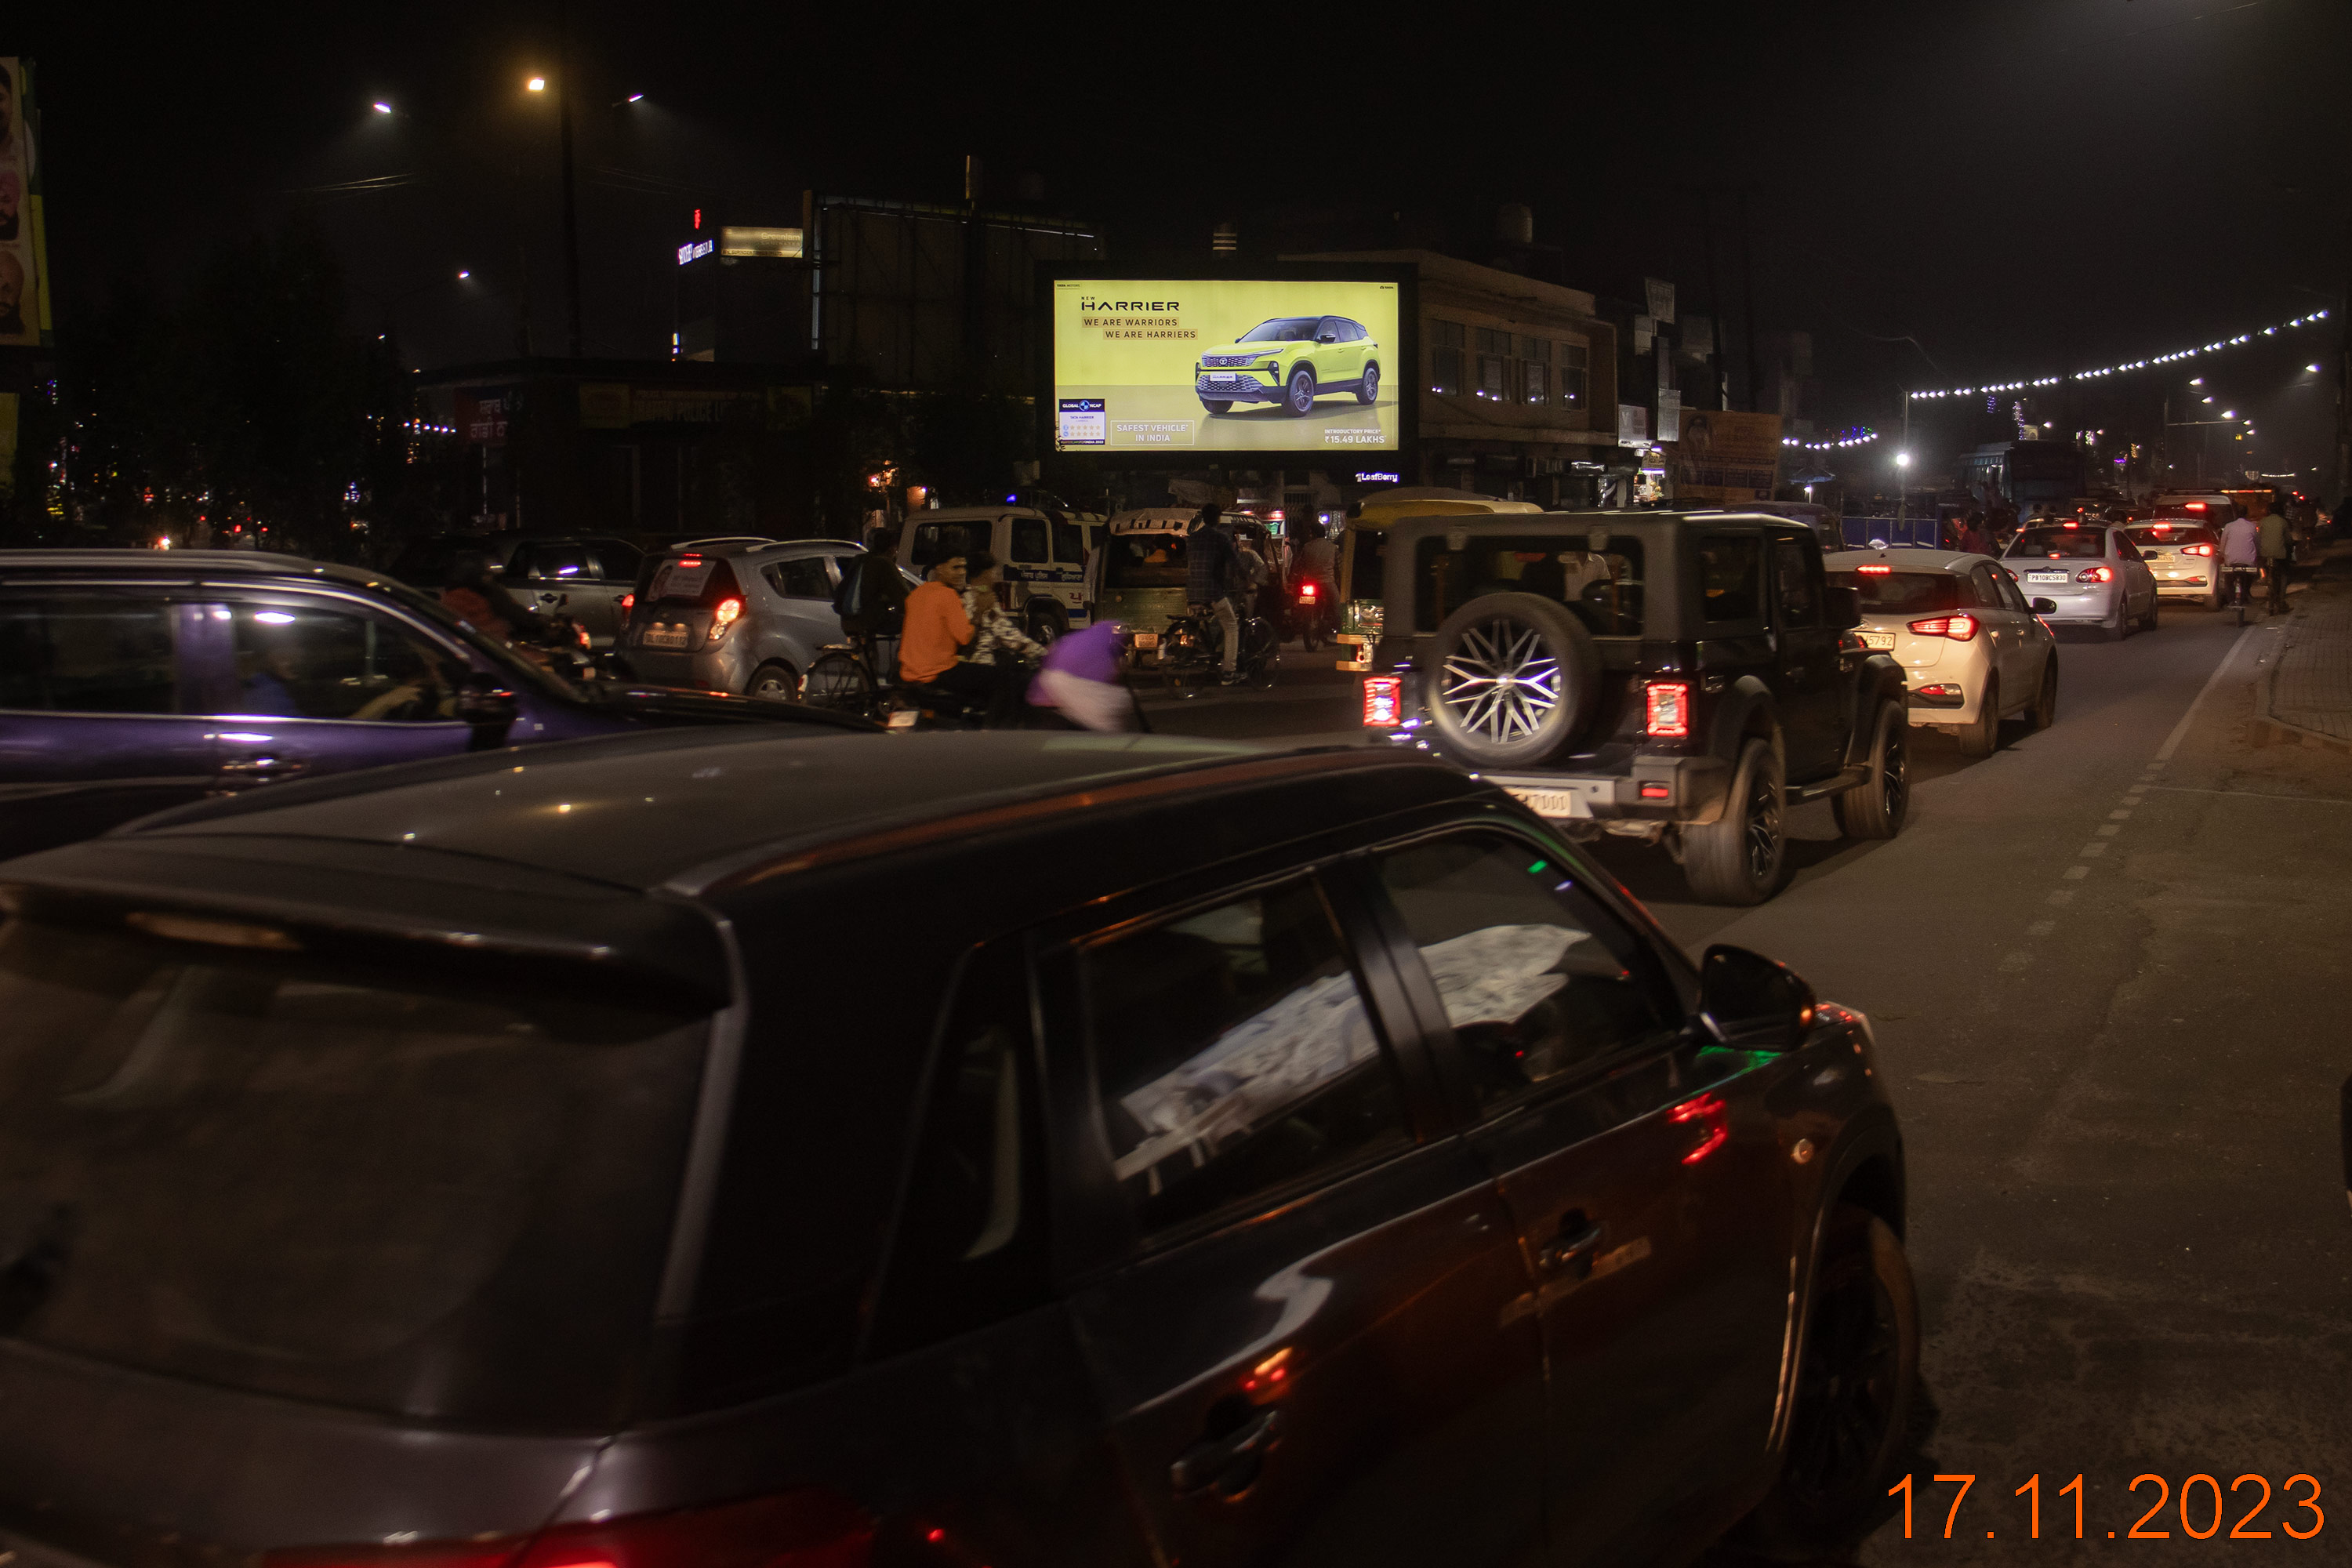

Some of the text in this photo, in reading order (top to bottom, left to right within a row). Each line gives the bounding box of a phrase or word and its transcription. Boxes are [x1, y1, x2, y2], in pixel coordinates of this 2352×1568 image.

[761, 232, 800, 241] Greenlam
[1081, 301, 1180, 311] HARRIER
[1866, 635, 1893, 646] 5792
